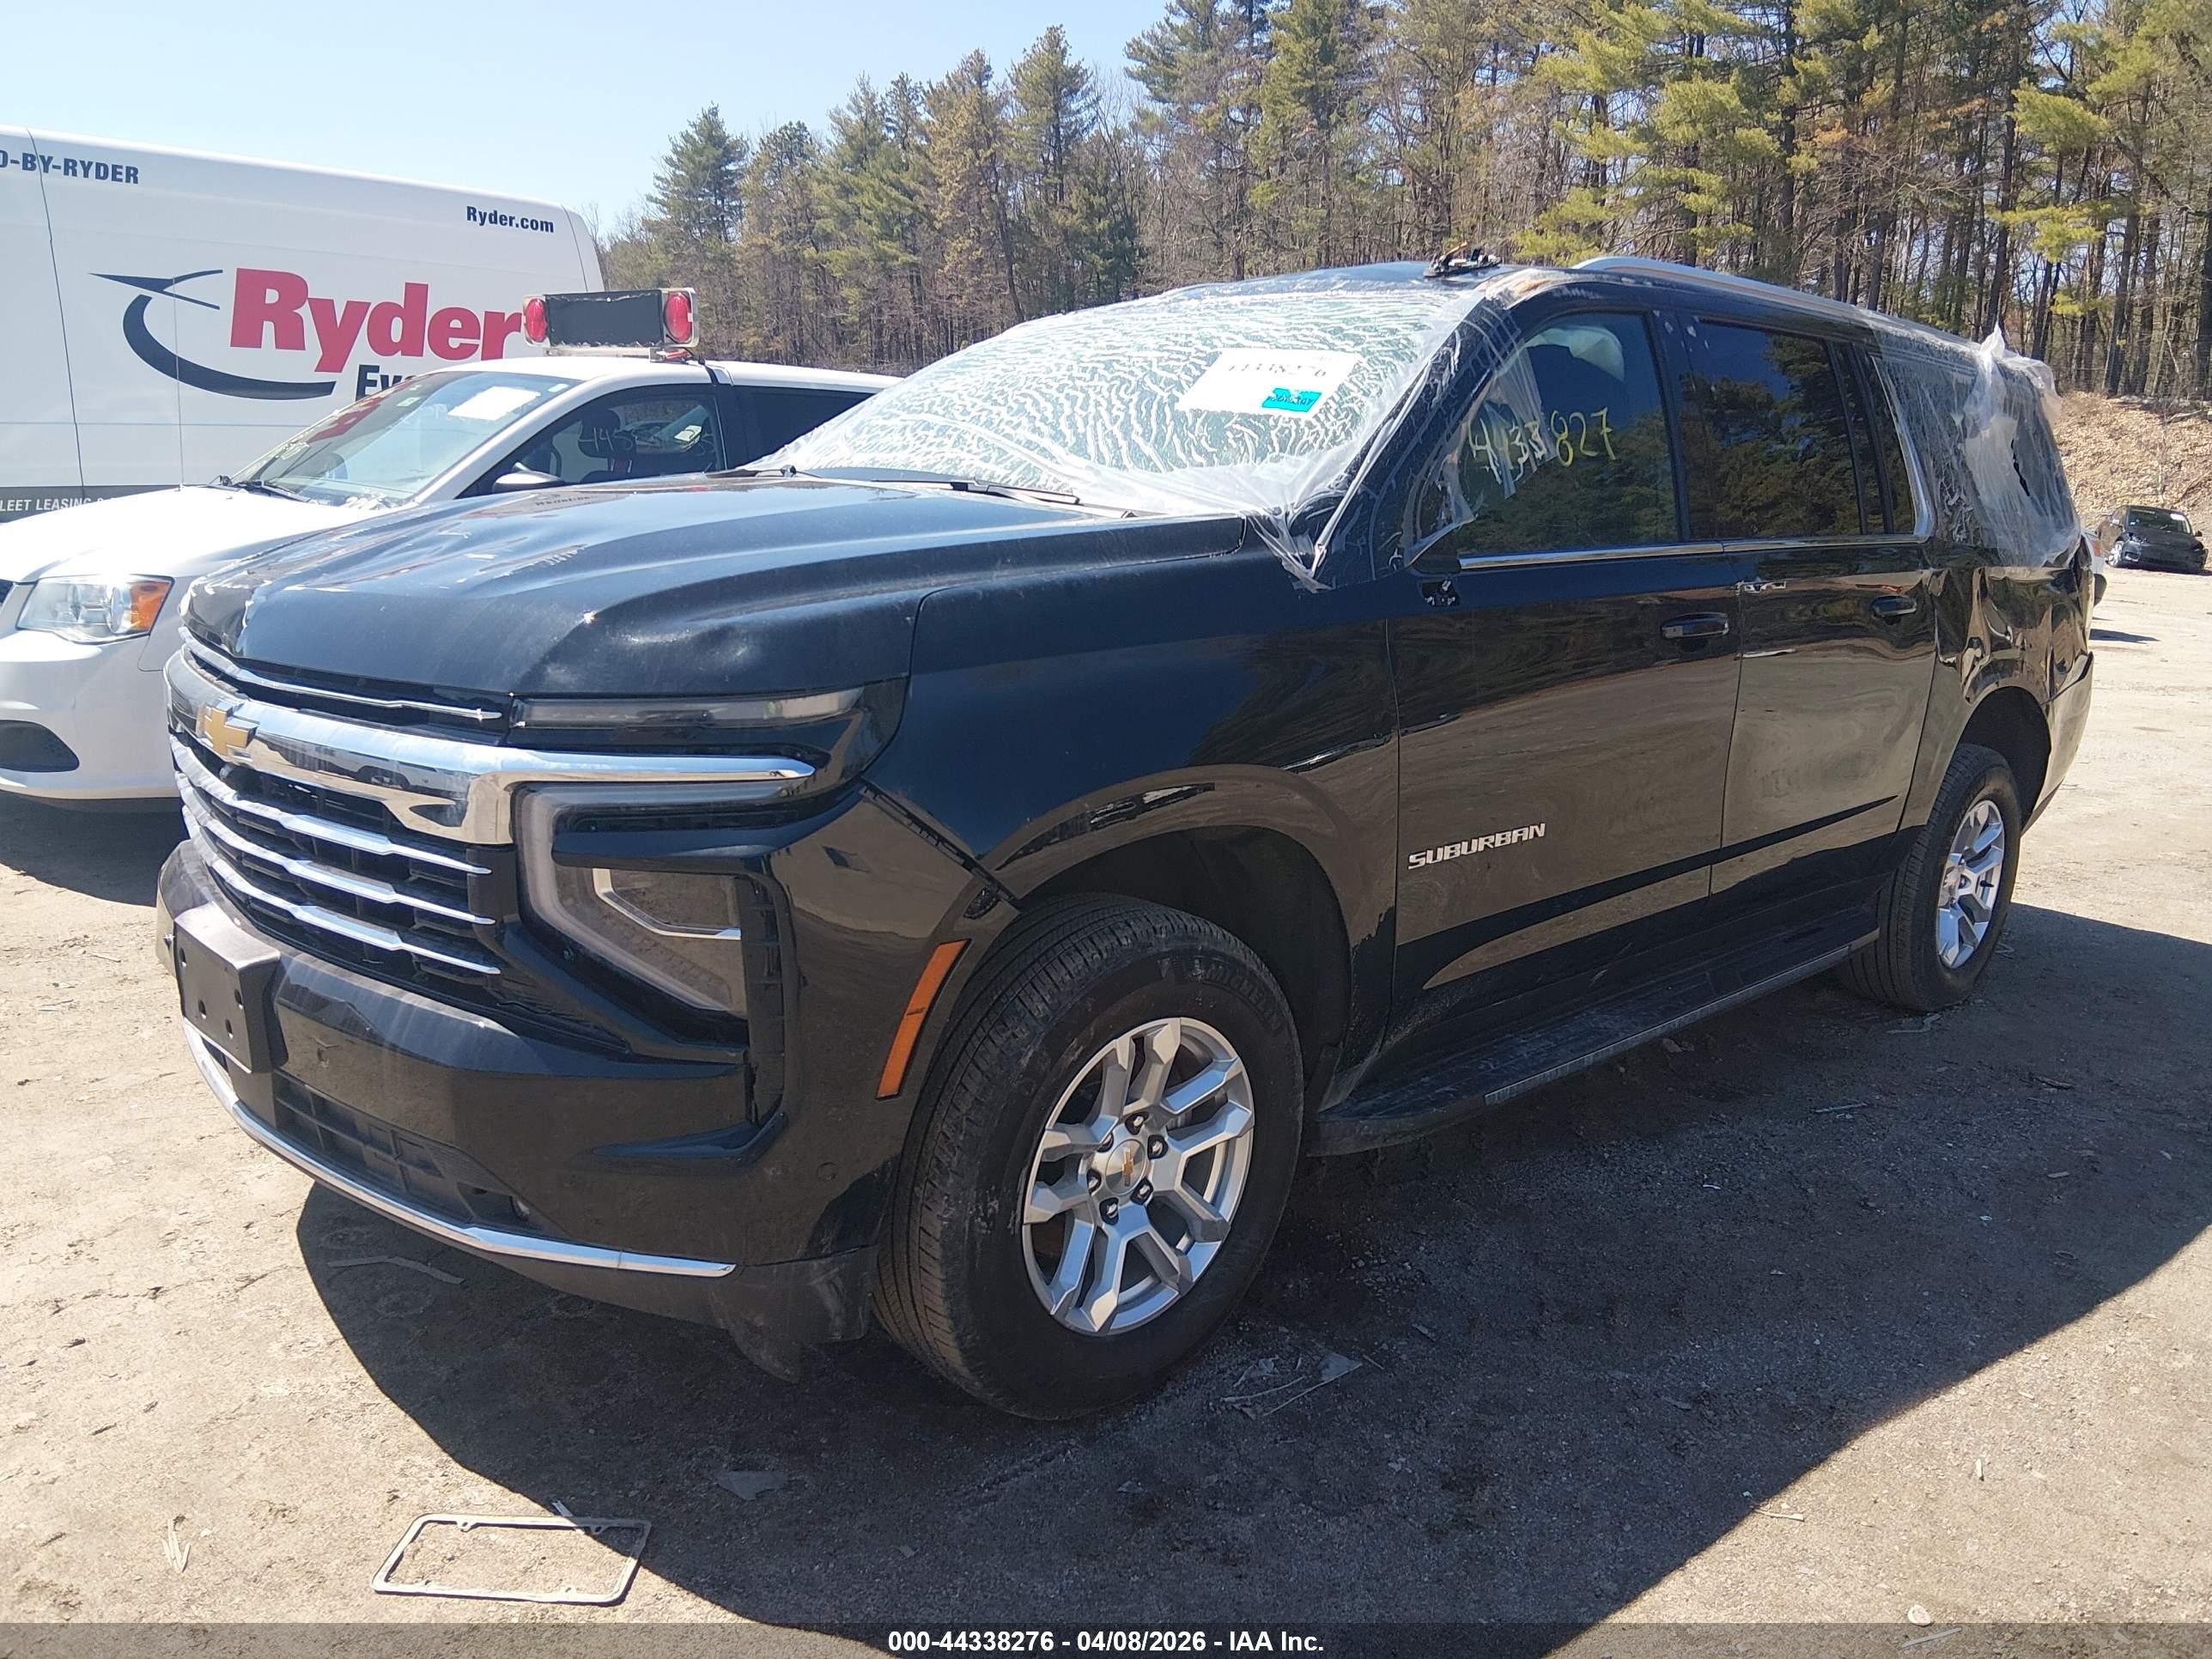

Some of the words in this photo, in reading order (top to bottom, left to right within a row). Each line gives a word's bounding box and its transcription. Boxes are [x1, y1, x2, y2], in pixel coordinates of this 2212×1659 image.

[466, 205, 555, 234] Ryder.com
[229, 267, 523, 374] Ryder
[356, 363, 417, 402] Ev
[1407, 822, 1546, 871] SUBURBAN
